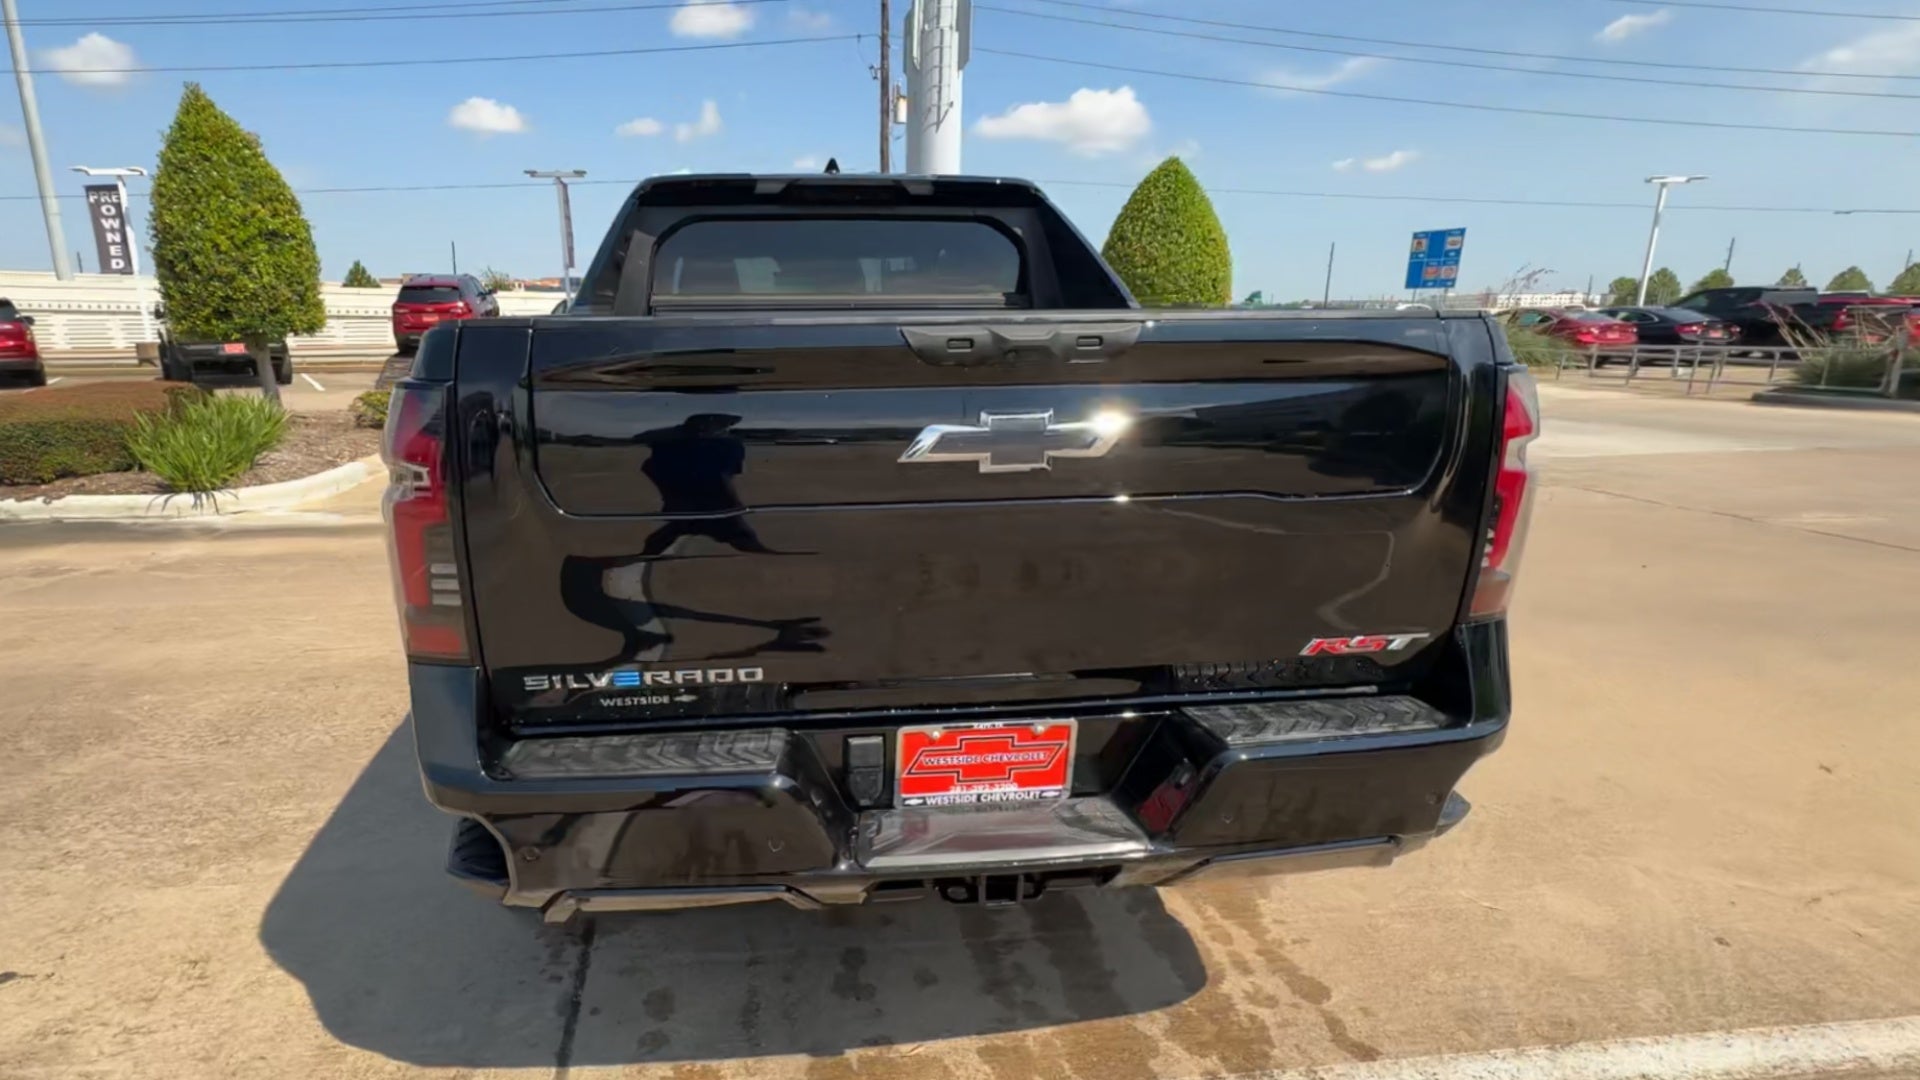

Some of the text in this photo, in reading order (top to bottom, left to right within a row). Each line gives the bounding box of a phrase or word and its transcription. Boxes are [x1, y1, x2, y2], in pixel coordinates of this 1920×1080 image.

[88, 191, 121, 203] PRE
[100, 205, 125, 269] OWNED
[1299, 632, 1430, 656] RST
[523, 667, 764, 691] SILVERADO
[600, 695, 671, 707] WESTSIDE
[922, 751, 1048, 766] WESTSIDE CHEVROLET
[925, 791, 1041, 806] WESTSIDE CHEVROLET
